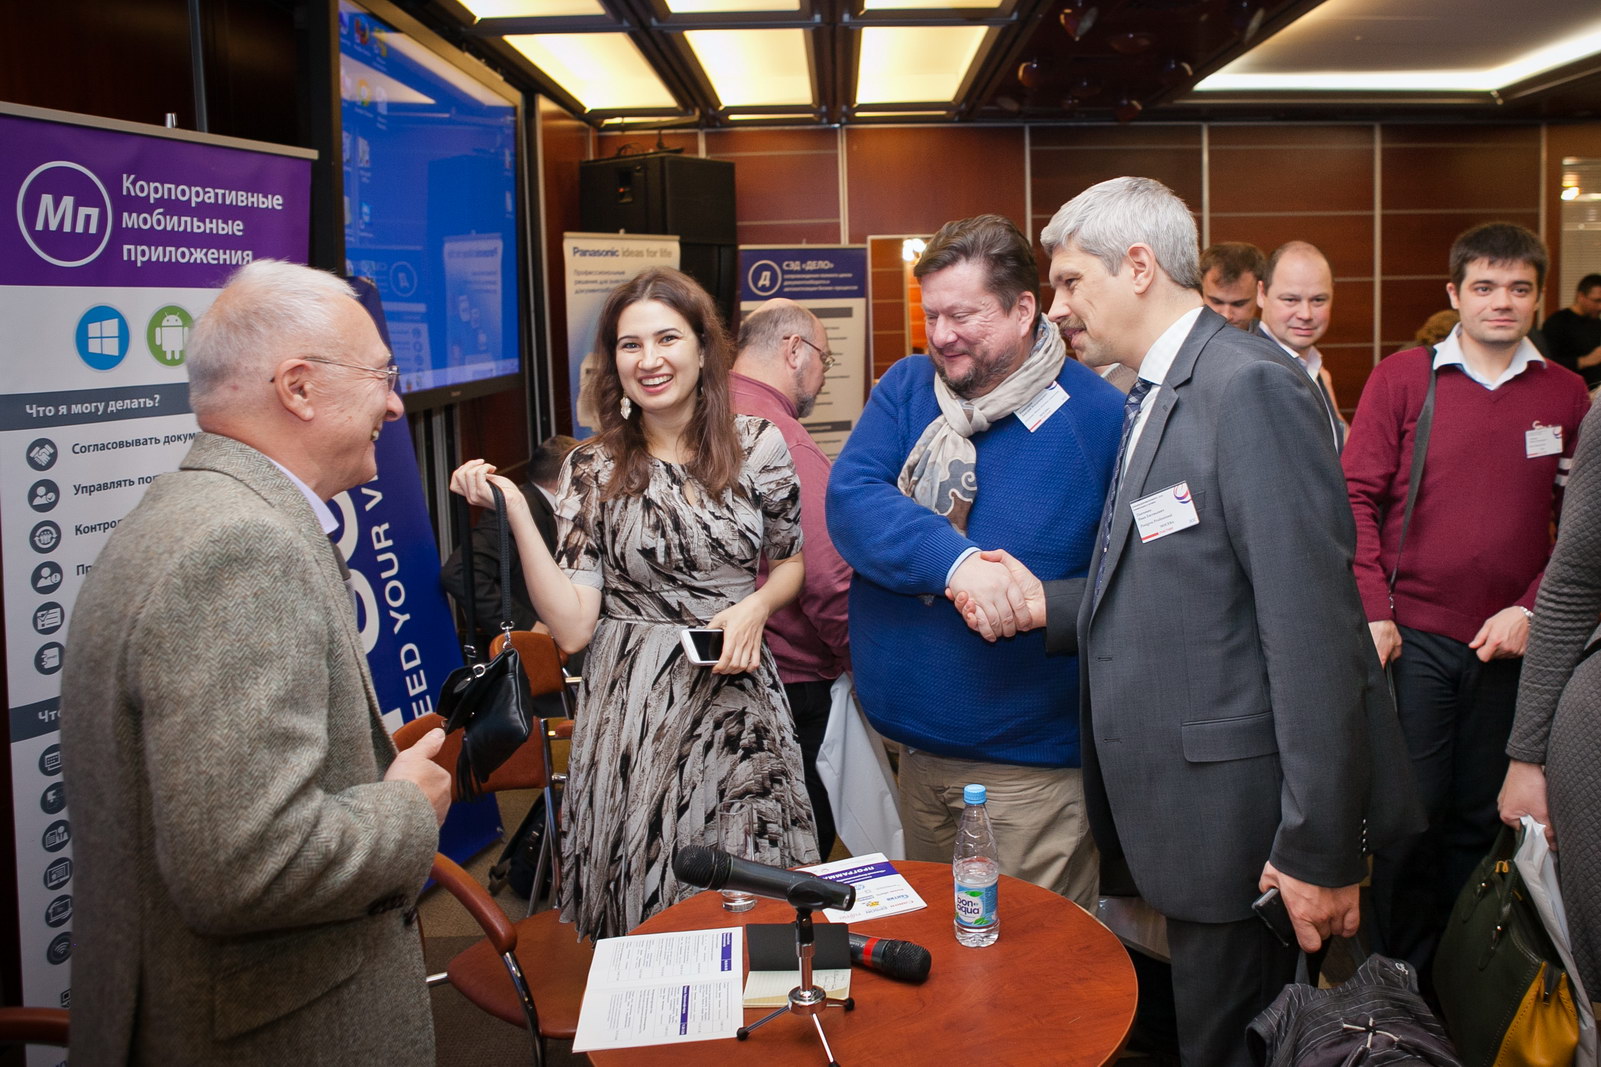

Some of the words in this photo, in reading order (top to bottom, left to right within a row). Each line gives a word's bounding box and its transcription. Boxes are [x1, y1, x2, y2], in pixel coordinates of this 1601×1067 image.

[122, 174, 284, 210] Корпоративные
[34, 193, 100, 234] Мп
[122, 208, 244, 236] мобильные
[122, 244, 253, 267] приложения
[572, 246, 619, 257] Panasonic
[621, 247, 645, 258] ideas
[646, 247, 659, 258] for
[660, 248, 673, 258] life
[25, 404, 55, 418] Что
[58, 404, 67, 415] я
[71, 402, 105, 415] могу
[107, 394, 161, 413] делать?
[71, 436, 161, 455] Согласовывать
[73, 478, 135, 496] Управлять
[75, 519, 124, 536] Контро
[371, 522, 411, 635] YOUR
